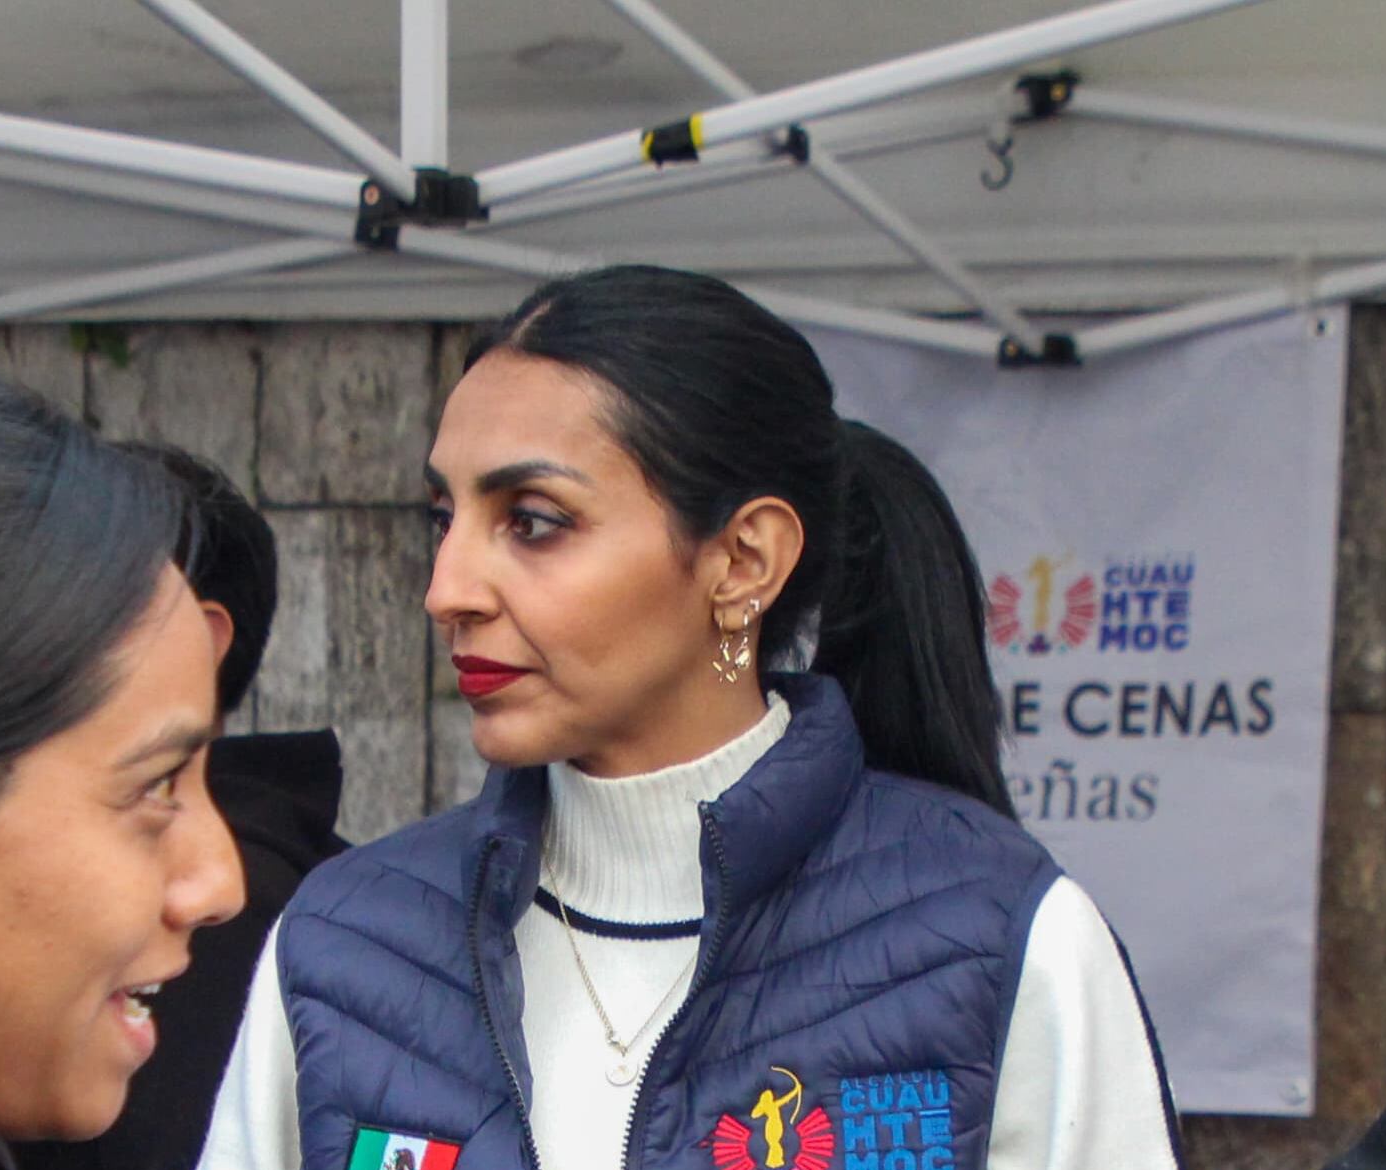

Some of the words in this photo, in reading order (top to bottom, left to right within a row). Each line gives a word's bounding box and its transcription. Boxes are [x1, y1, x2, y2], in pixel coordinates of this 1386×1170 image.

[1104, 562, 1195, 586] CUAU
[1102, 590, 1189, 618] HTE
[1099, 623, 1189, 653] MOC
[1065, 678, 1274, 737] CENAS
[841, 1082, 949, 1114] CUAU
[843, 1109, 952, 1151] HTE
